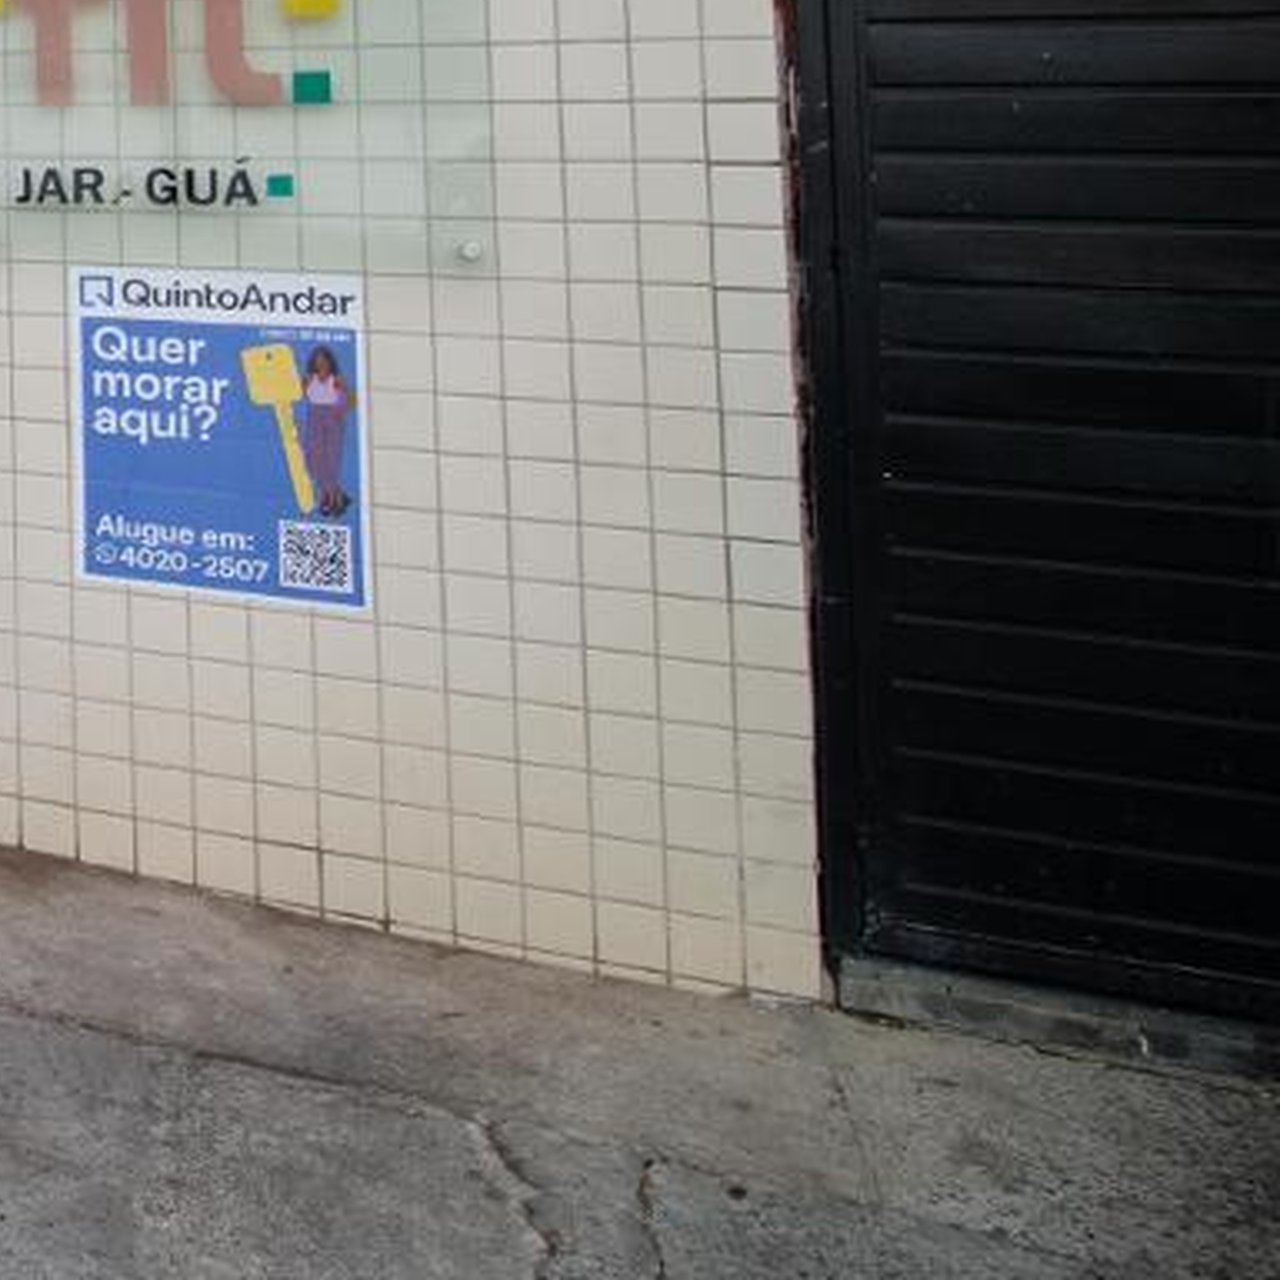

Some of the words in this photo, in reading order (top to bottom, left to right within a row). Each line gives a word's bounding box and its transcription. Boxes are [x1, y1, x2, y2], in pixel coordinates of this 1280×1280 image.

[15, 156, 258, 206] JARGUÁ
[122, 278, 355, 316] QuintoAndar
[92, 325, 206, 366] Quer
[93, 369, 229, 406] morar
[93, 403, 218, 445] aqui?
[95, 514, 195, 547] Alugue
[201, 528, 255, 551] em:
